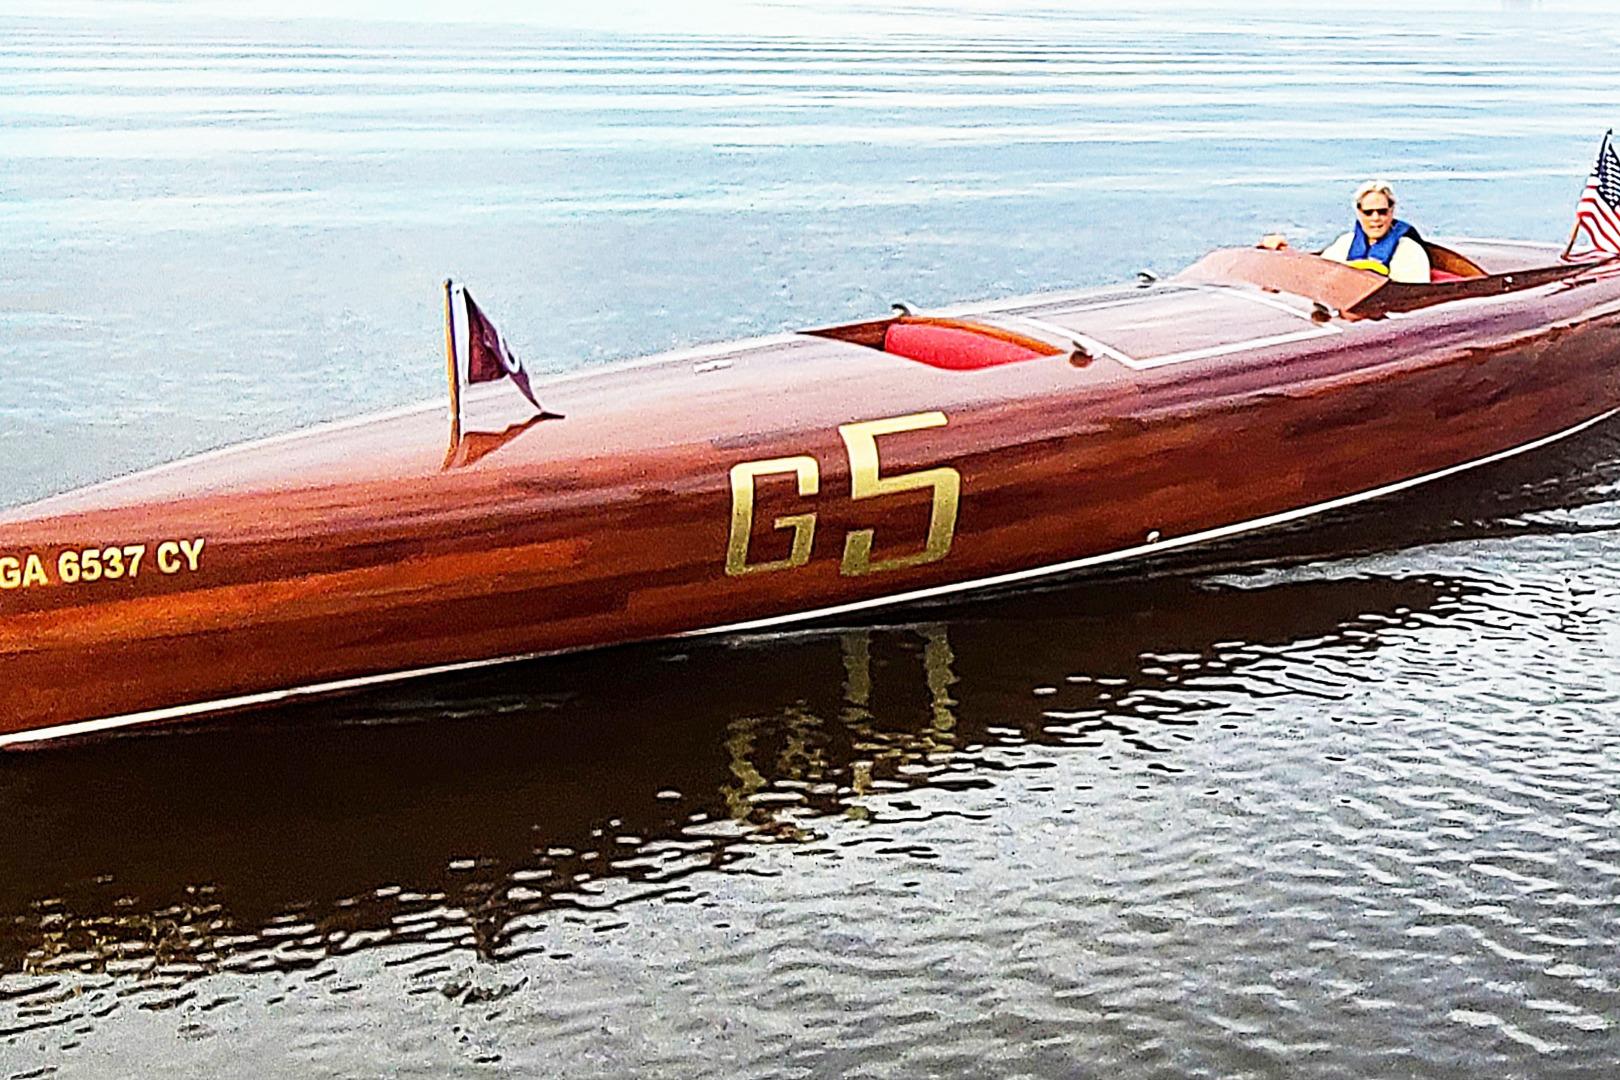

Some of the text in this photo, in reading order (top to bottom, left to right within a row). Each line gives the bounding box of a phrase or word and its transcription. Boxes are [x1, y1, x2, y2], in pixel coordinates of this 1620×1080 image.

[725, 411, 961, 576] G5
[0, 538, 205, 589] GA 6537 CY
